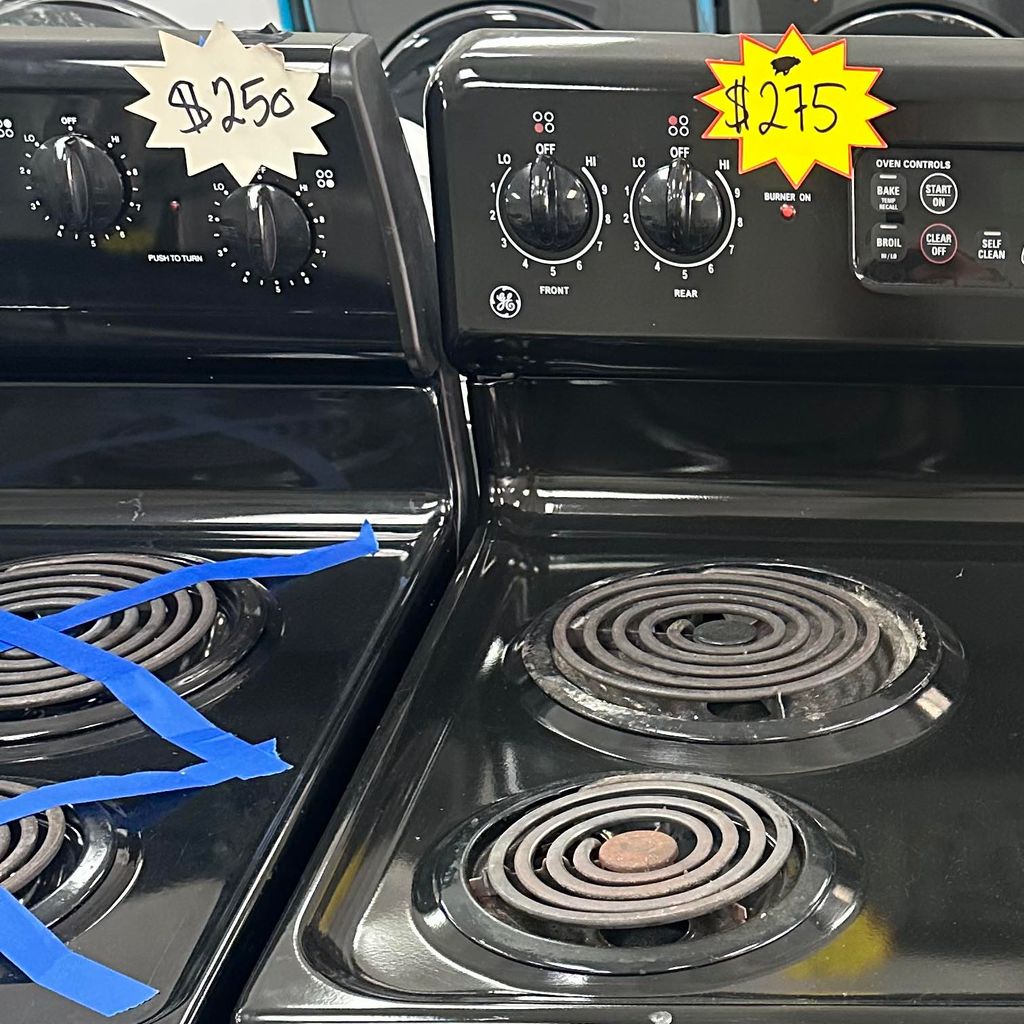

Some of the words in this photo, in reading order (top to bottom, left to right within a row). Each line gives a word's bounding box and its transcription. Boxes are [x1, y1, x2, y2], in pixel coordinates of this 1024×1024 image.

[168, 76, 295, 134] $250
[725, 75, 847, 135] $275
[60, 117, 77, 125] OFF
[23, 134, 36, 143] LO
[110, 135, 120, 144] HI
[535, 143, 556, 156] OFF
[670, 146, 690, 158] OFF
[498, 153, 512, 165] LO
[585, 156, 597, 167] HI
[632, 157, 646, 168] LO
[876, 159, 901, 168] OVEN
[903, 159, 951, 169] CONTROLS
[719, 159, 730, 171] HI
[213, 182, 225, 191] LO
[299, 183, 309, 192] HI
[490, 182, 496, 193] 1
[601, 184, 608, 195] 9
[624, 185, 630, 196] 1
[877, 185, 900, 196] BAKE
[925, 184, 952, 194] START
[734, 187, 741, 199] 9
[764, 192, 796, 201] BURNER
[799, 193, 812, 202] ON
[932, 197, 945, 207] ON
[489, 209, 496, 221] 2
[604, 213, 612, 225] 8
[623, 213, 630, 224] 2
[737, 217, 744, 228] 8
[500, 237, 508, 249] 3
[876, 238, 902, 248] BROIL
[926, 233, 952, 243] CLEAR
[597, 241, 603, 252] 7
[633, 241, 640, 251] 3
[729, 244, 735, 255] 7
[982, 239, 1002, 249] SELF
[931, 247, 946, 256] OFF
[978, 250, 1006, 260] CLEAN
[147, 254, 170, 263] PUSH
[170, 254, 182, 263] TO
[182, 254, 203, 263] TURN
[522, 258, 529, 269] 4
[576, 260, 583, 271] 6
[654, 261, 661, 272] 4
[707, 263, 714, 274] 6
[550, 266, 557, 277] 5
[682, 269, 689, 280] 5
[539, 286, 570, 295] FRONT
[674, 289, 698, 298] REAR
